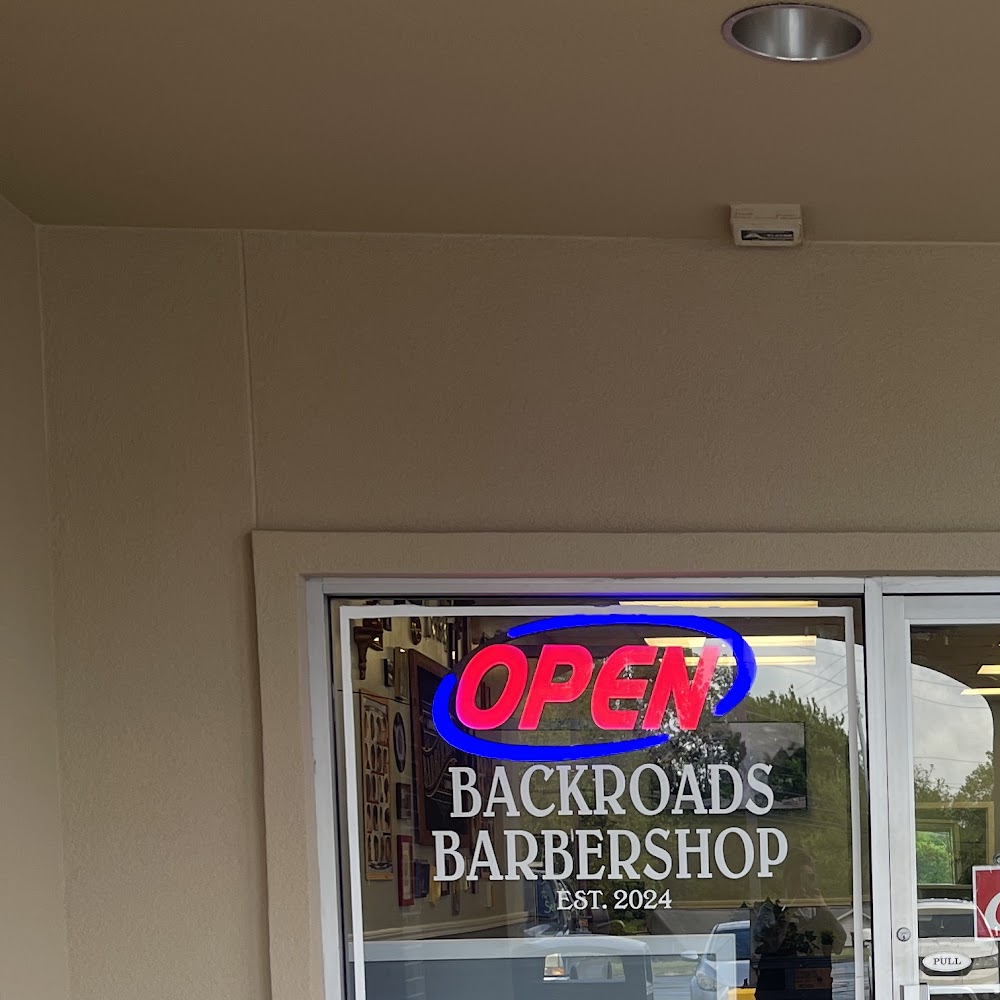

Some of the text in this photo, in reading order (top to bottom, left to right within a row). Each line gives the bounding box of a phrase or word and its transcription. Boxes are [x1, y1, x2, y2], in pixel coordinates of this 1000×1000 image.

[454, 643, 722, 732] OPEN
[450, 763, 775, 818] BACKROADS
[433, 827, 789, 882] BARBERSHOP
[557, 890, 608, 910] EST.
[614, 889, 672, 910] 2024
[933, 957, 962, 966] PULL
